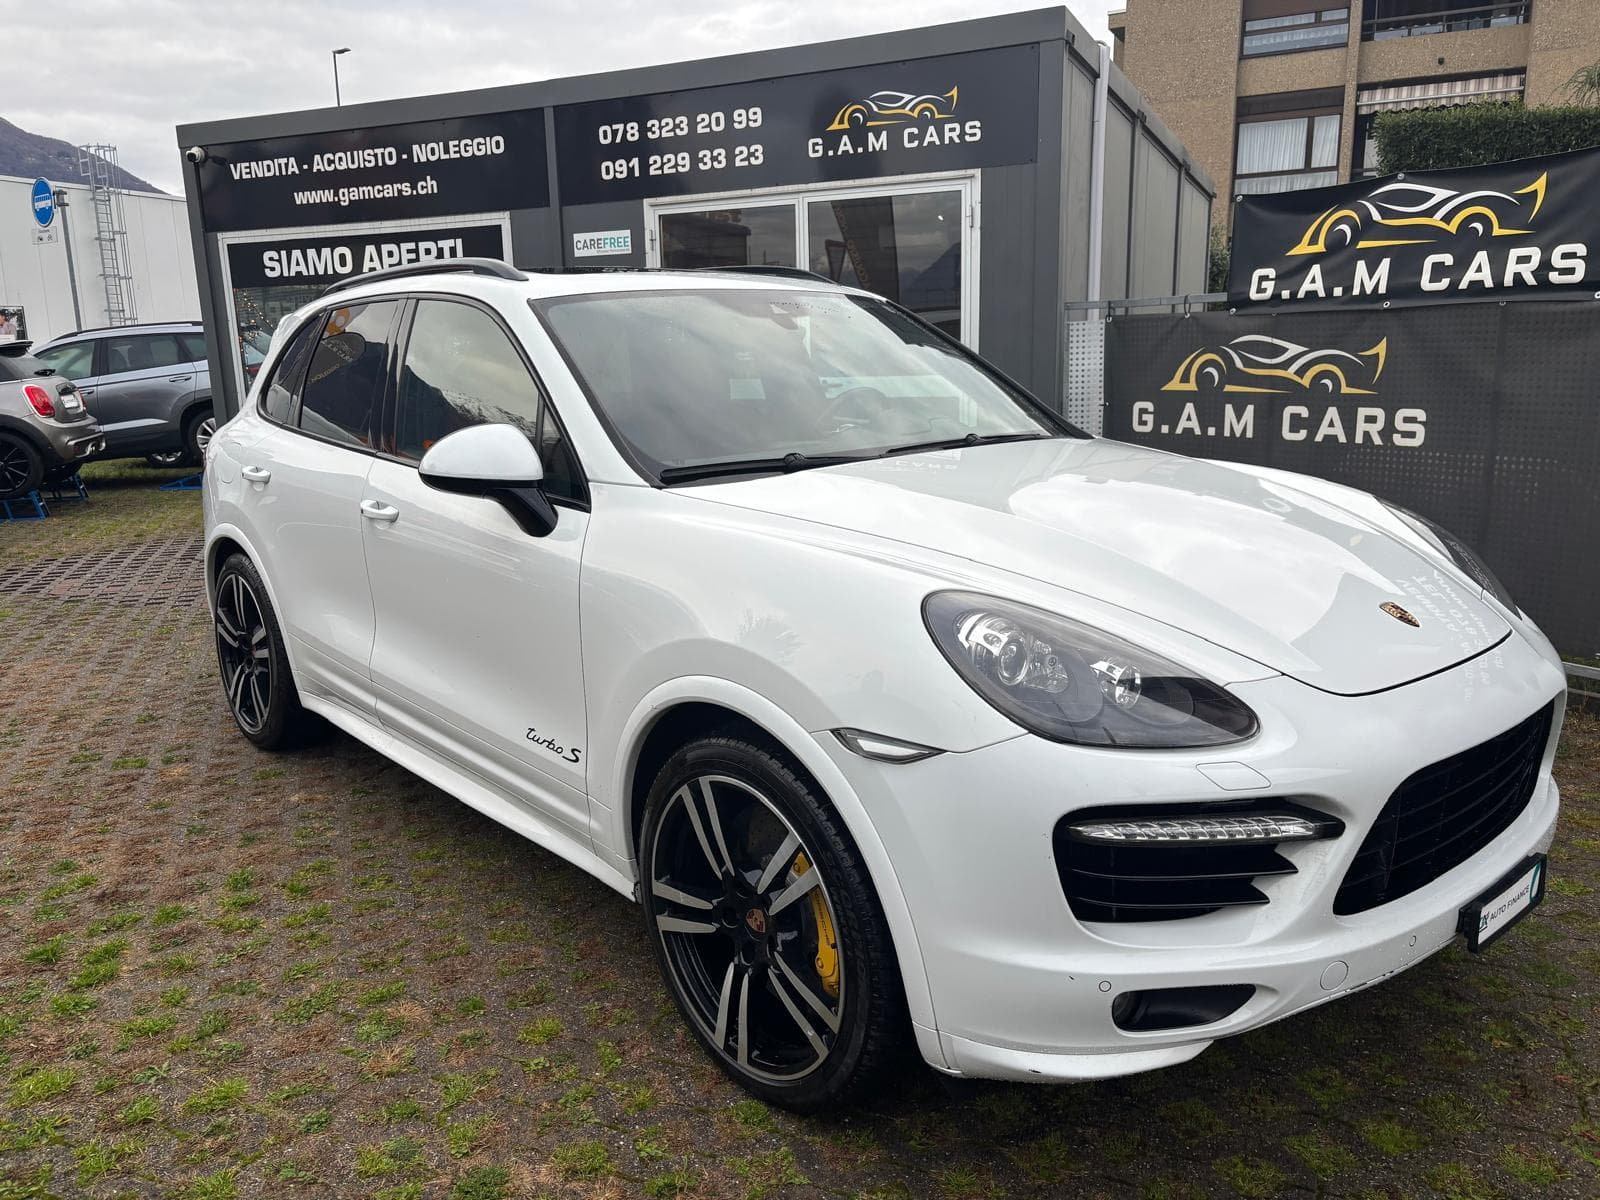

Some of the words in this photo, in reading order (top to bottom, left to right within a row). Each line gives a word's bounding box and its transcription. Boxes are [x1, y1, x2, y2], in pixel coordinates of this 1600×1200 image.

[599, 121, 640, 145] 078
[646, 116, 689, 139] 323
[696, 111, 725, 134] 20
[733, 107, 763, 130] 99
[807, 130, 888, 158] G.A.M
[903, 120, 982, 148] CARS
[229, 156, 300, 180] VENDITA
[312, 146, 397, 173] ACQUISTO
[412, 135, 505, 163] NOLEGGIO
[600, 157, 640, 180] 091
[648, 152, 691, 176] 229
[698, 148, 727, 171] 33
[734, 144, 764, 167] 23
[293, 175, 438, 206] www.gamcars.ch
[262, 246, 354, 278] SIAMO
[362, 238, 464, 273] APERTI
[575, 236, 630, 251] CAREFREE
[1248, 258, 1391, 301] G.A.M
[1420, 242, 1588, 292] CARS
[1132, 401, 1255, 439] G.A.M
[1281, 405, 1427, 447] CARS
[526, 727, 563, 754] turbo
[562, 748, 582, 763] S
[1490, 904, 1507, 921] AUTO
[1507, 884, 1530, 909] FINANCE
